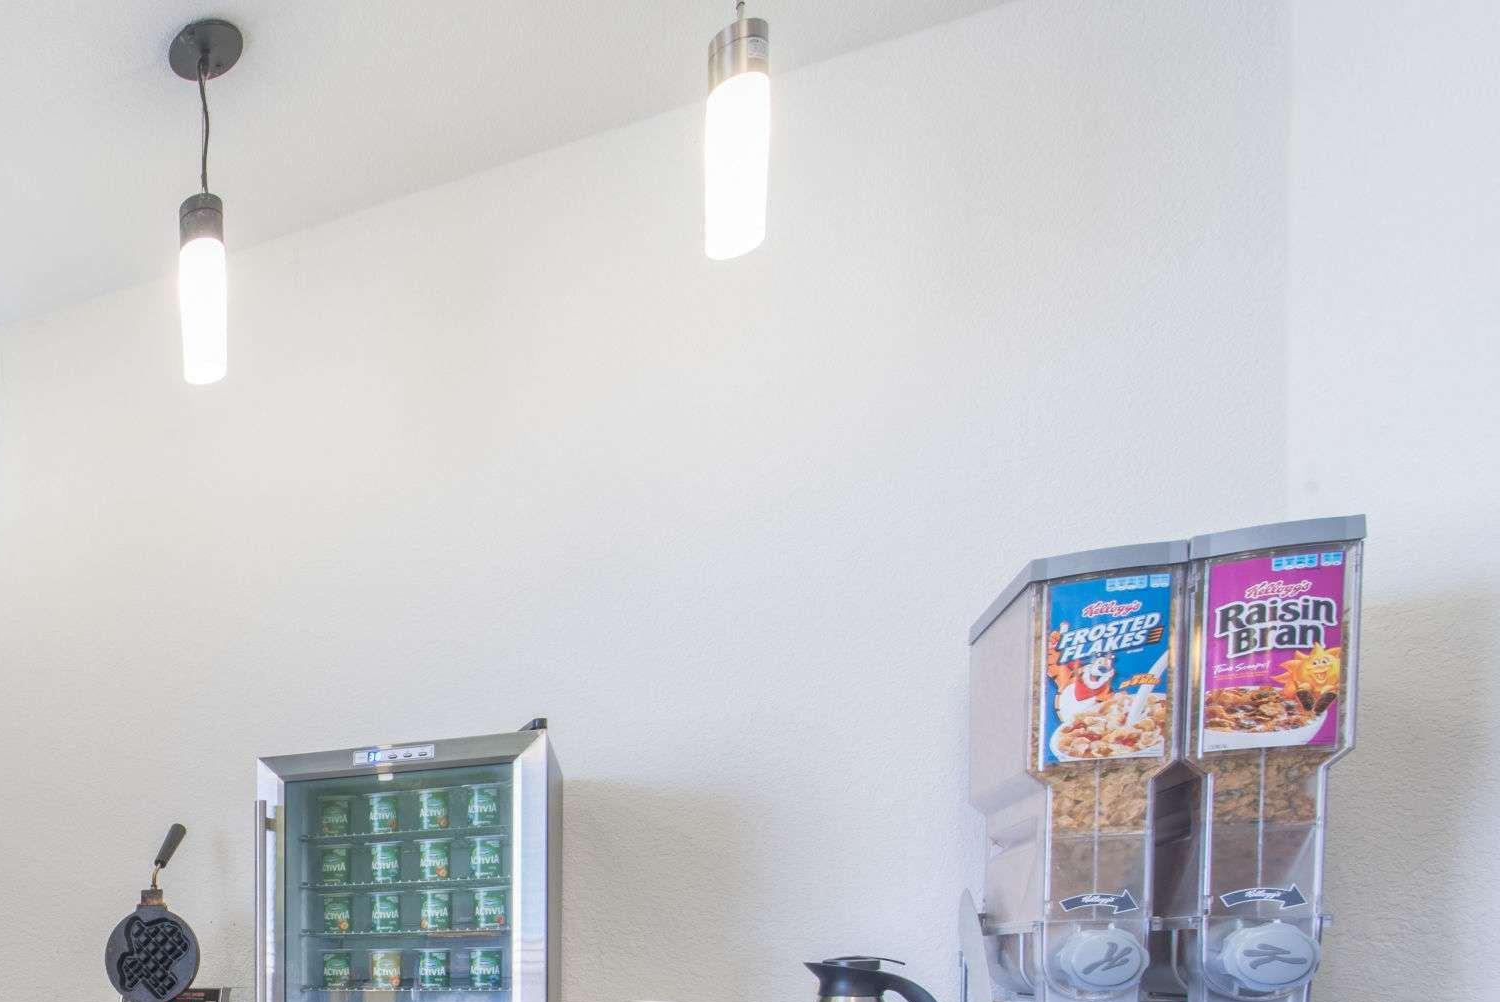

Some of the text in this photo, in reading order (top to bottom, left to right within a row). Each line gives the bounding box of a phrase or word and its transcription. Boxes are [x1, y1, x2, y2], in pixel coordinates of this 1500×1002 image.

[1244, 580, 1312, 599] Kellogg's
[1082, 600, 1142, 618] Kellogg's
[1215, 596, 1338, 637] Raisin
[1059, 612, 1160, 649] FROSTED
[1060, 629, 1149, 663] FLAKES
[1227, 623, 1325, 658] Bran
